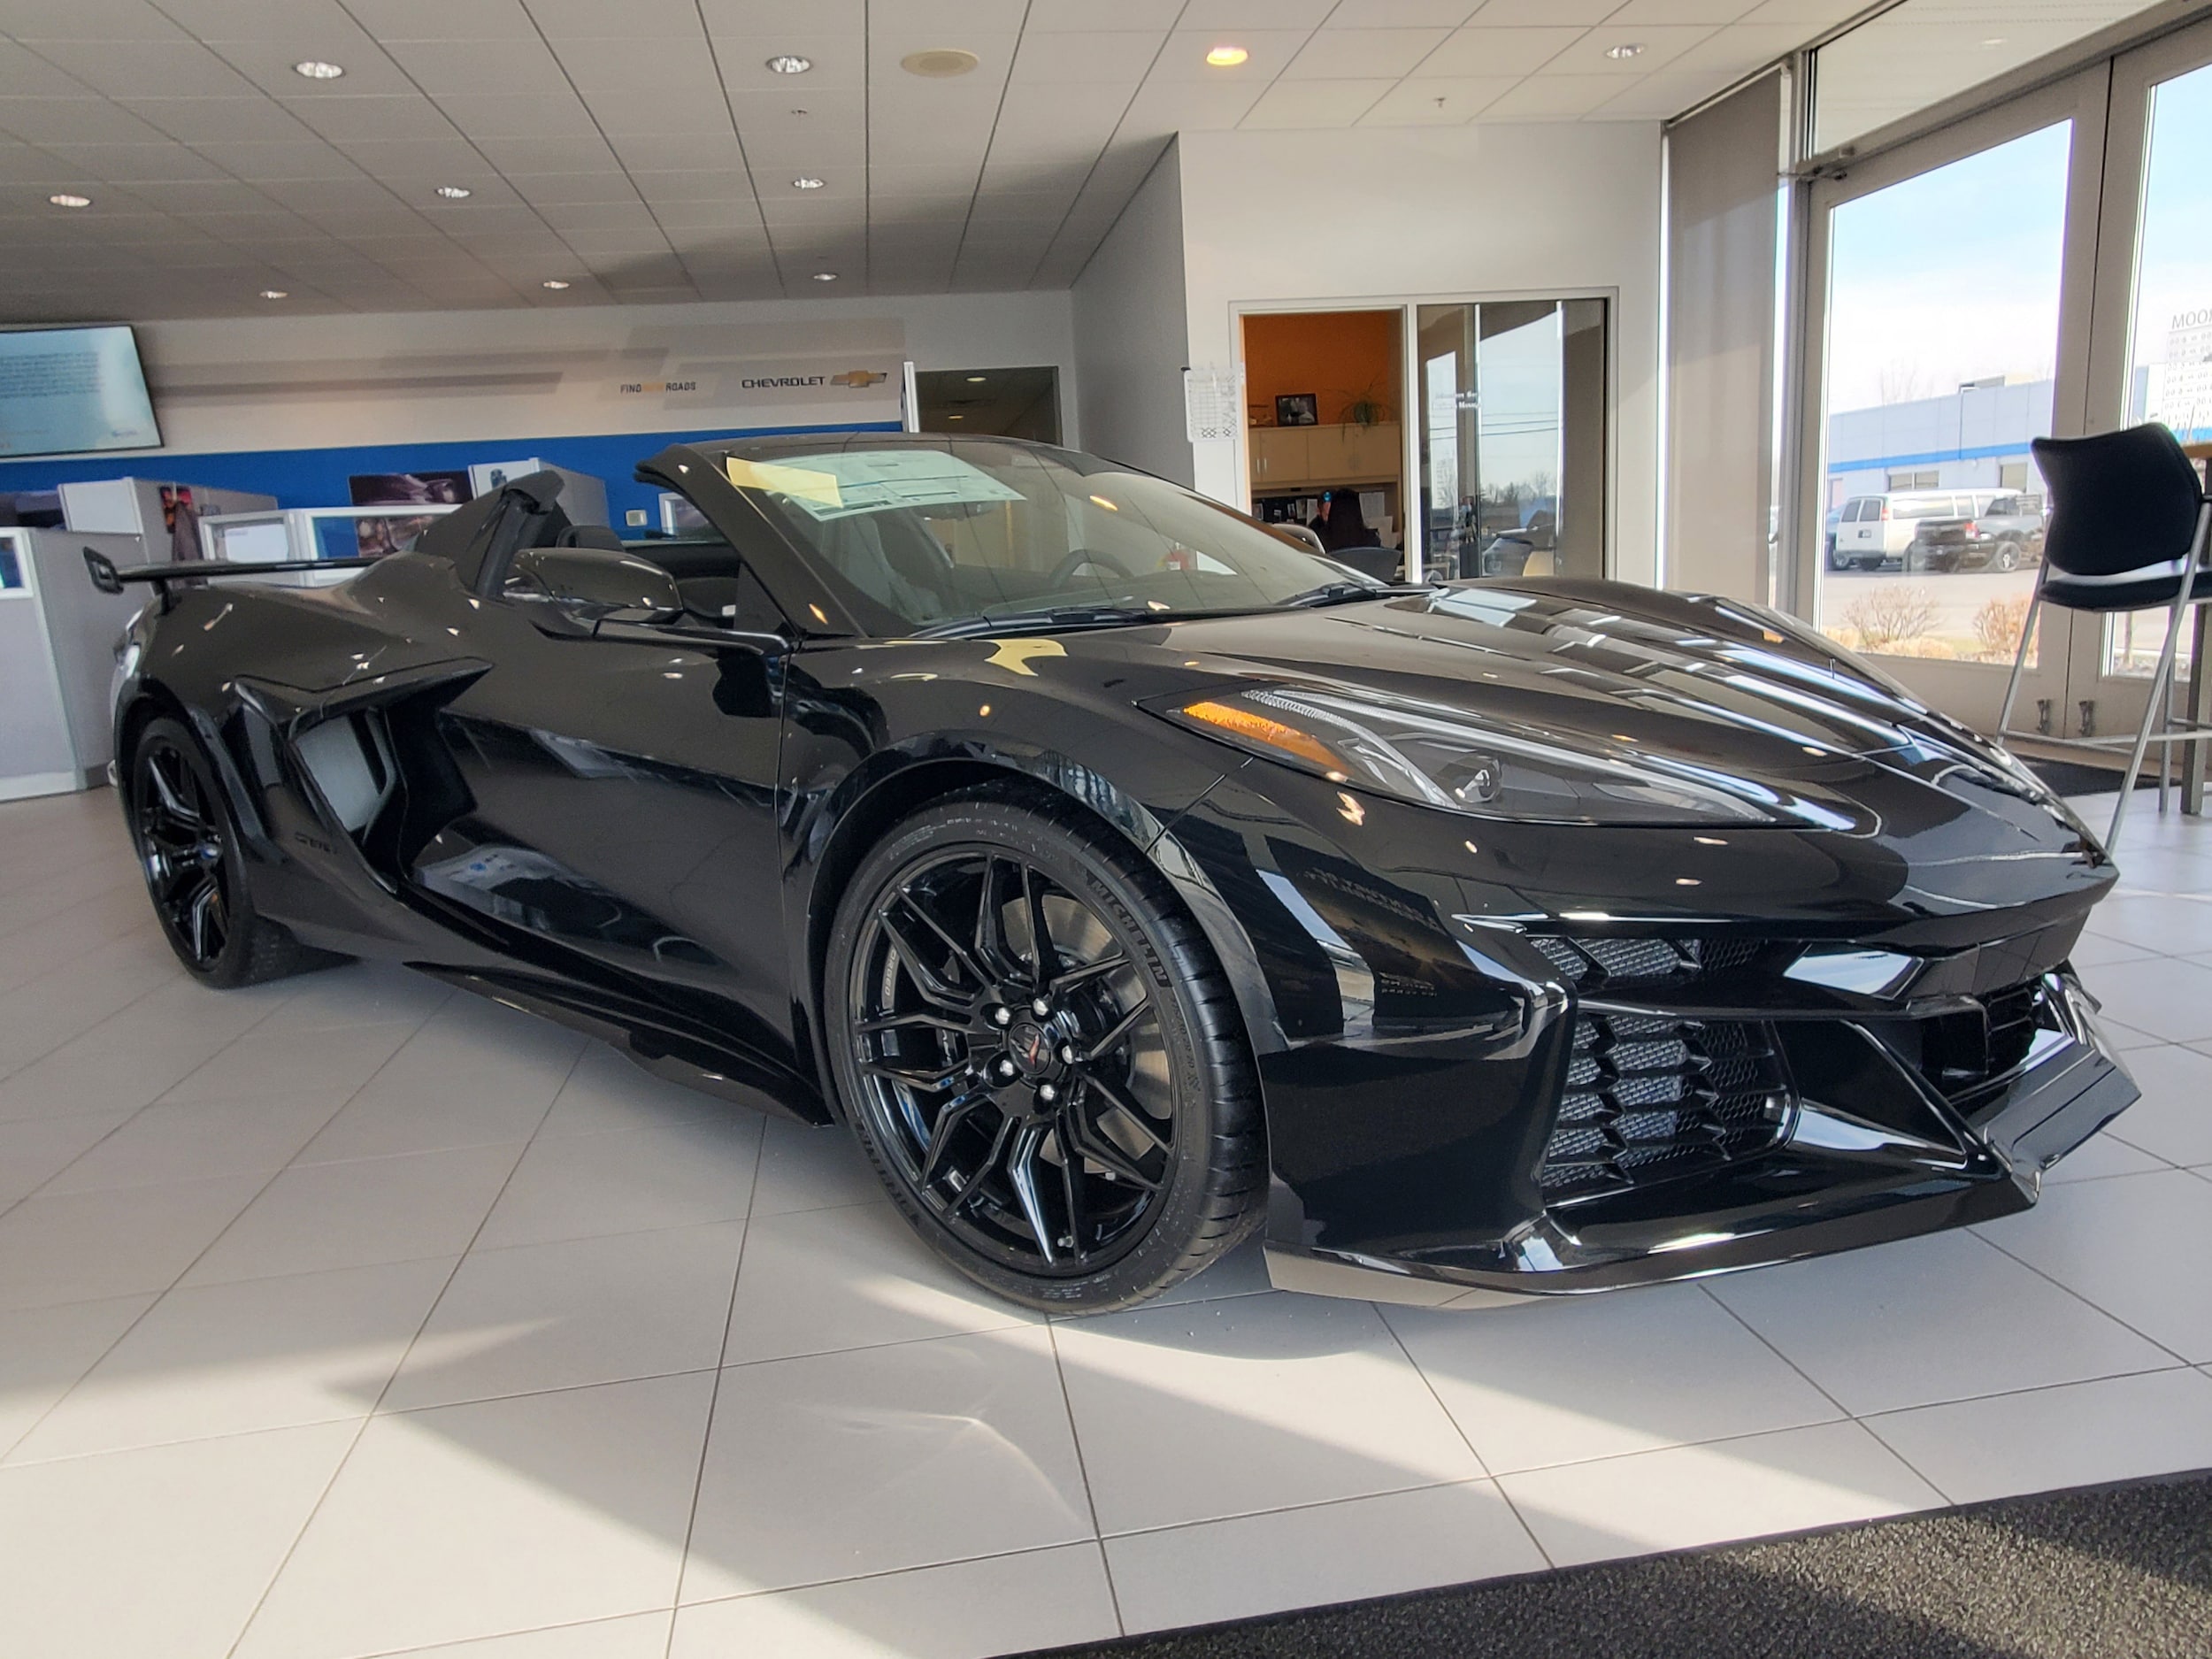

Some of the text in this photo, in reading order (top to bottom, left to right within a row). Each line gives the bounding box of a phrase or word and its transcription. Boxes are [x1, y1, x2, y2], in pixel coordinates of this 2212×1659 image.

[620, 383, 642, 394] FIND
[665, 381, 696, 392] ROADS
[741, 376, 826, 388] CHEVROLET
[1090, 879, 1168, 983] MICHELIN
[884, 949, 897, 996] ORGED
